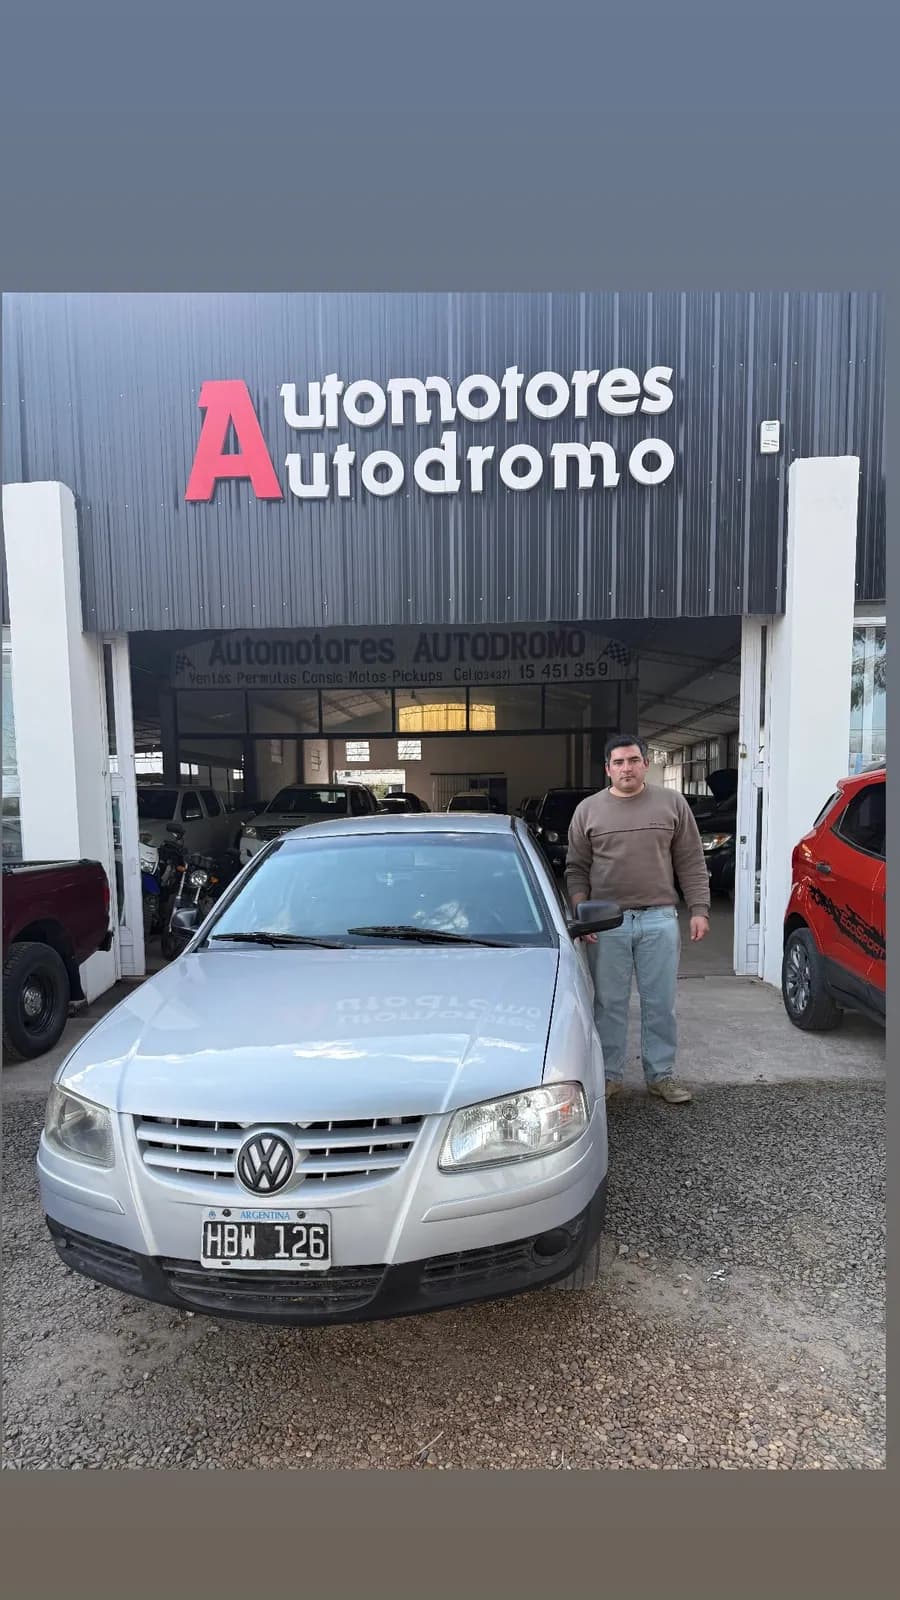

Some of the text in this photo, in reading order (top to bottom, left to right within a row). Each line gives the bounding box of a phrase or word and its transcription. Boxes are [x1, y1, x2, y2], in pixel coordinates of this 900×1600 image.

[208, 630, 586, 666] Automotores AUTODROMO
[519, 664, 535, 679] 15
[541, 663, 568, 678] 451
[573, 662, 608, 678] 359
[240, 1210, 290, 1221] ARGENTINA
[206, 1223, 325, 1259] HBW 126
